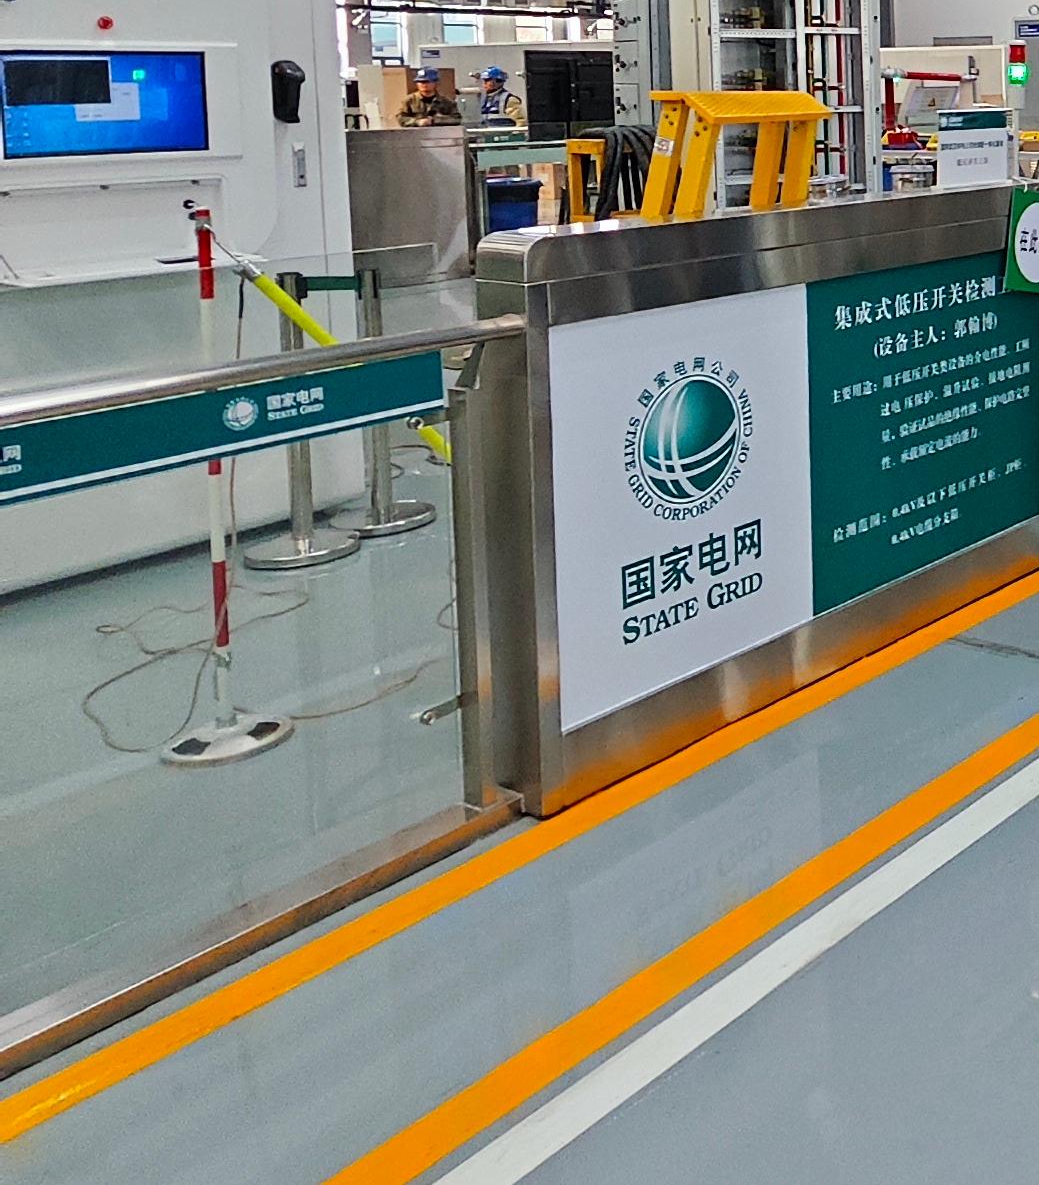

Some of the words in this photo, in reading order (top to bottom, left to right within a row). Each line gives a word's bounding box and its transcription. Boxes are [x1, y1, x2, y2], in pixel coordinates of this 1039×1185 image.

[266, 387, 324, 410] 国家电网
[638, 357, 740, 407] 国家电网公司
[267, 408, 298, 421] STATE
[738, 388, 753, 438] CHINA
[0, 444, 22, 464] 网
[624, 416, 641, 472] STATE
[740, 441, 750, 464] OF
[628, 474, 654, 509] GRID
[653, 466, 741, 520] CORPORATION
[621, 519, 762, 610] 国家电网
[622, 596, 699, 645] STATE
[706, 572, 763, 610] GRID
